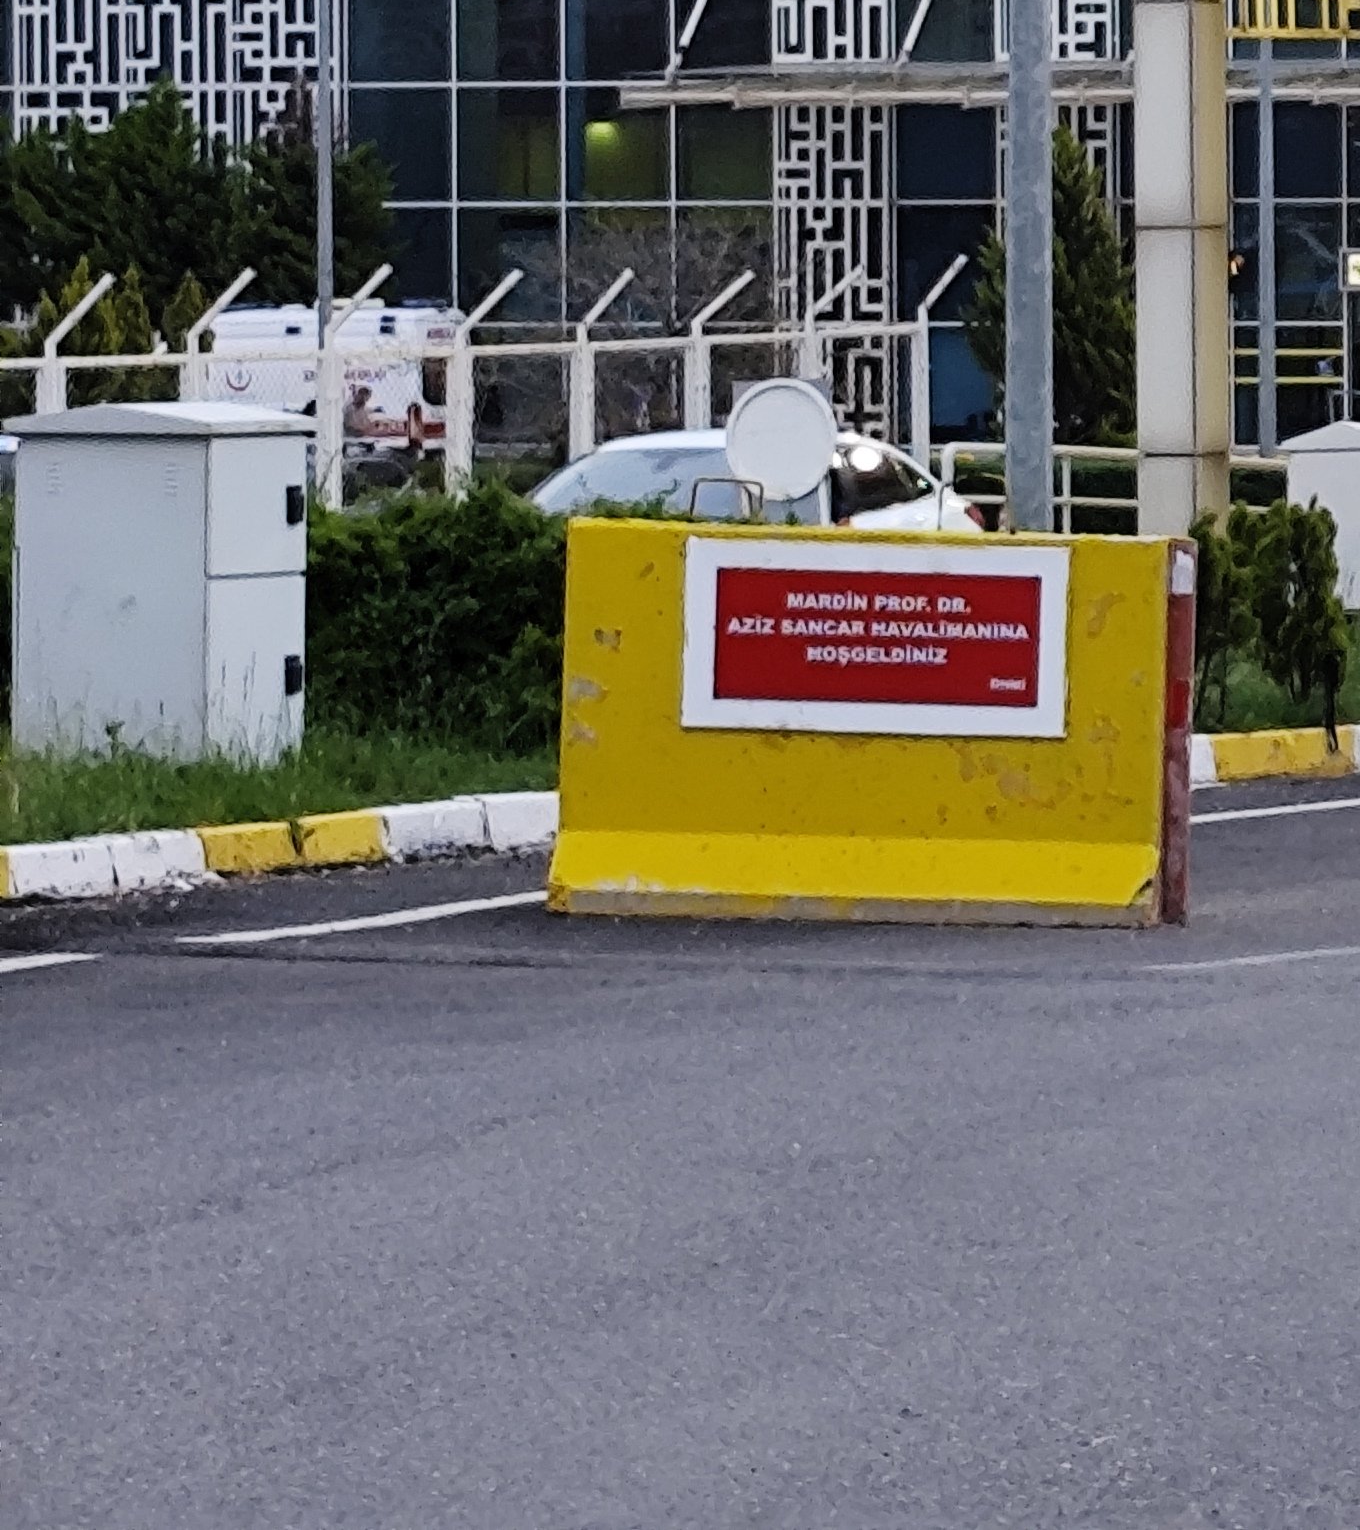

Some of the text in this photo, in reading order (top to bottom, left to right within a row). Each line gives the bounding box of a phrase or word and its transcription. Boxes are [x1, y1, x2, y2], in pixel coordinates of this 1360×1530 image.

[786, 589, 868, 613] MARDİN
[874, 594, 932, 613] PROF.
[726, 614, 775, 636] AZİZ
[781, 619, 865, 637] SANCAR
[806, 643, 948, 668] HOŞGELDİNİZ
